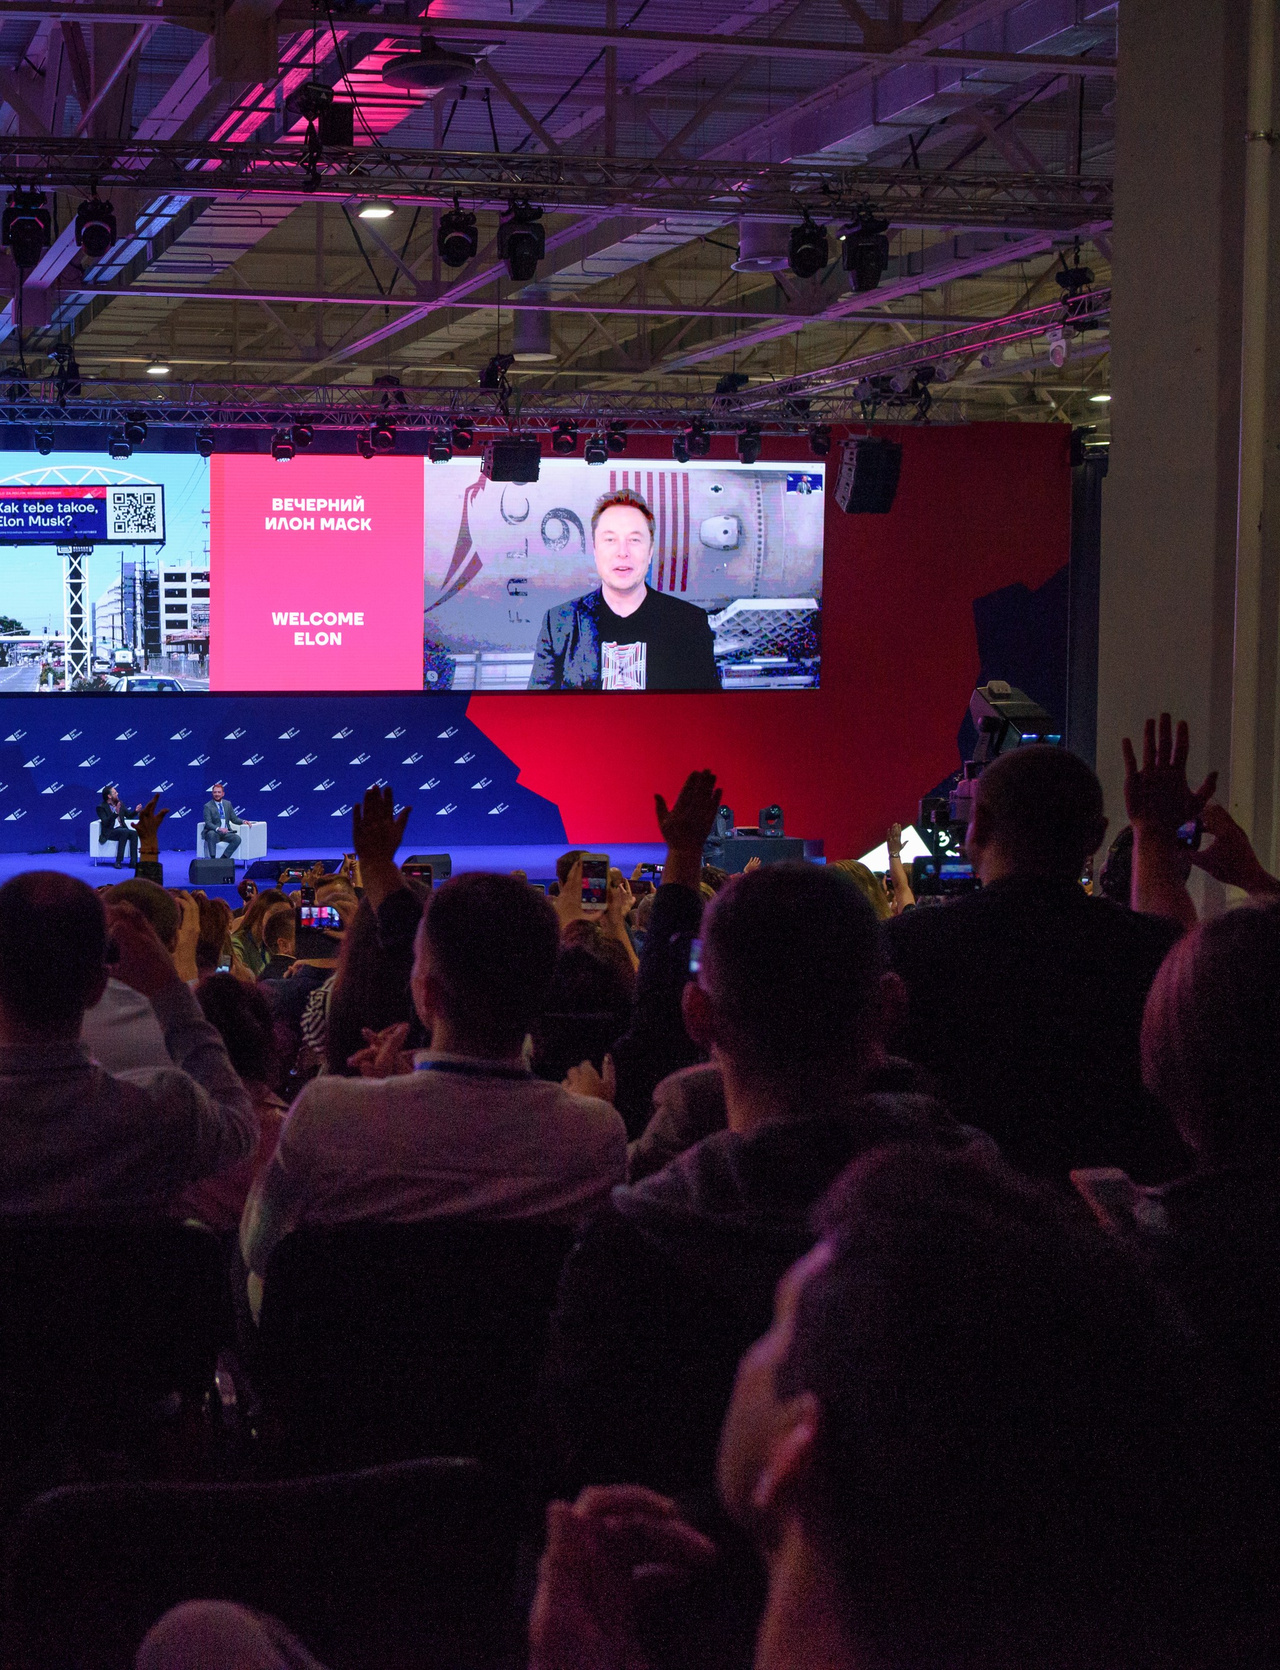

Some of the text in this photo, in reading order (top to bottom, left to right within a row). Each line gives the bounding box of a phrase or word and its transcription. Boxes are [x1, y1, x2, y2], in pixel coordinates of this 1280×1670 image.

[23, 501, 54, 514] tebe
[57, 501, 99, 515] takoe,
[272, 495, 365, 512] ВЕЧЕРНИЙ
[28, 514, 73, 527] Musk?
[265, 517, 372, 531] ИЛОН МАСК
[272, 611, 365, 626] WELCOME
[294, 632, 342, 646] ELON
